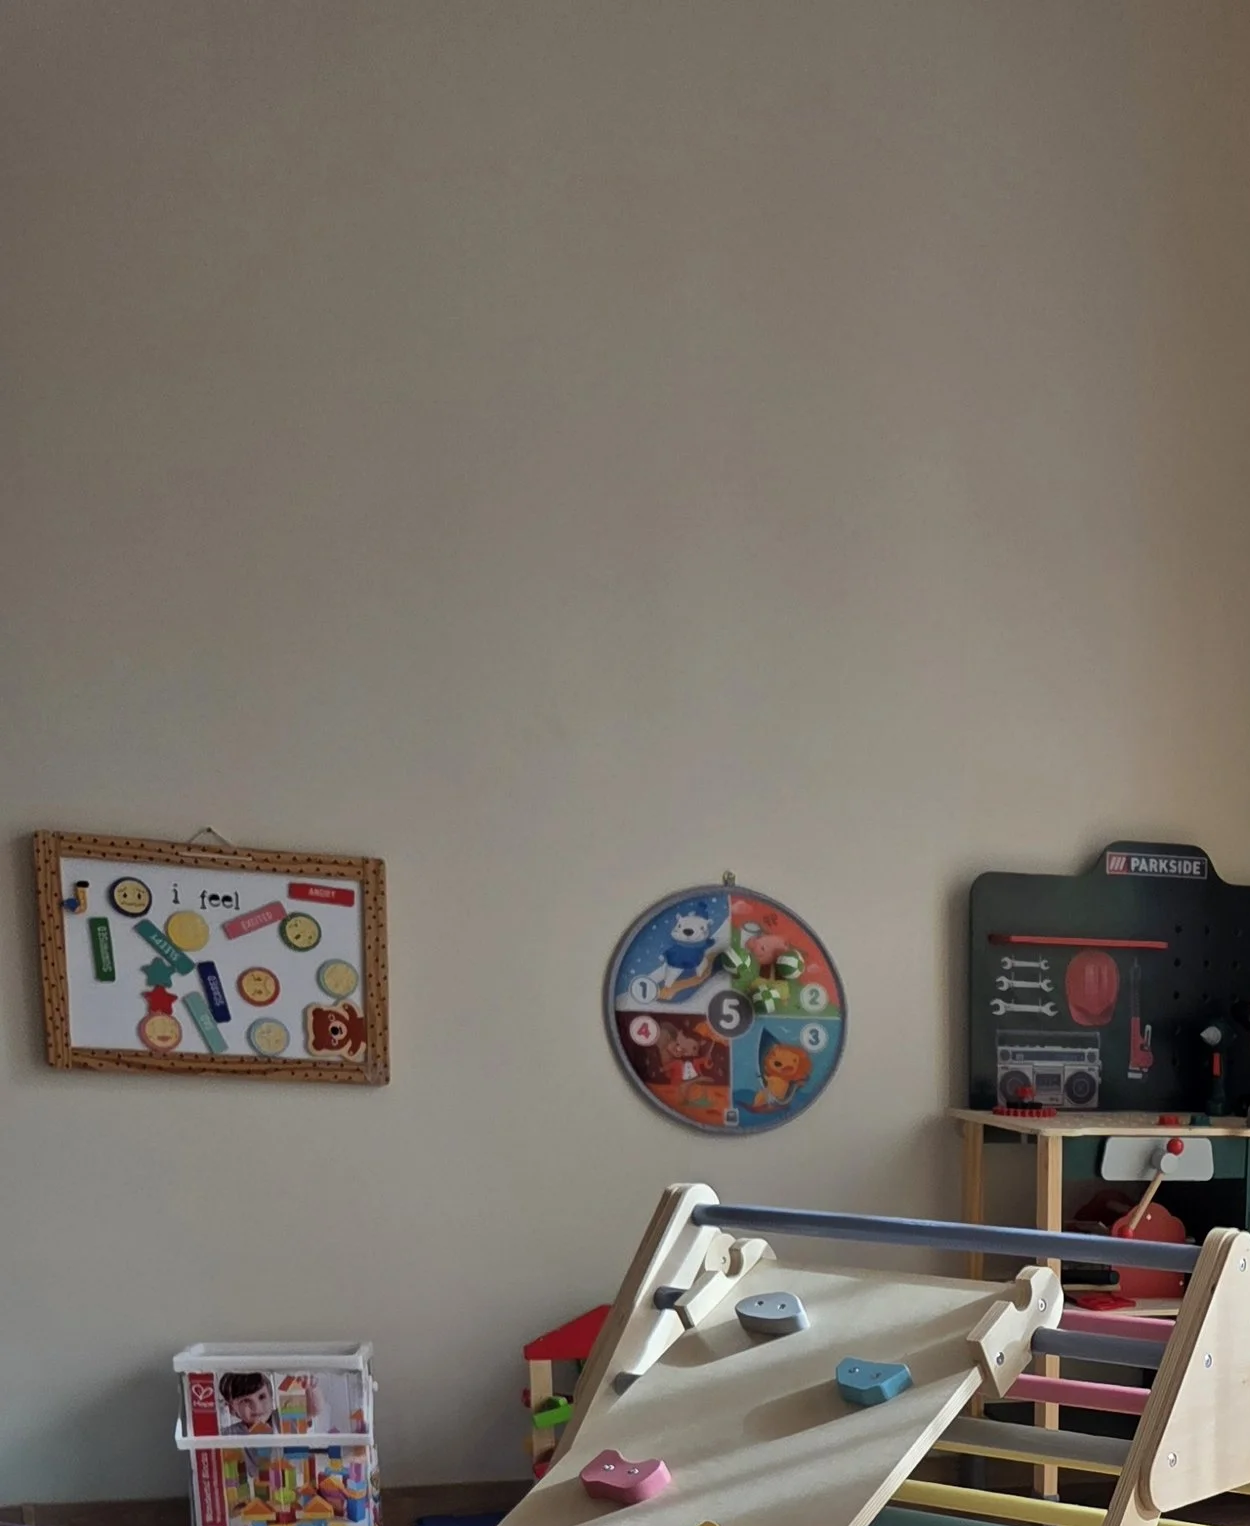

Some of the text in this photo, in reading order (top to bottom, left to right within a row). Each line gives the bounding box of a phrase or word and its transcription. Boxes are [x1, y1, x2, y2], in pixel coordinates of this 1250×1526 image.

[1130, 857, 1201, 875] PARKSIDE
[172, 883, 240, 910] i feel
[308, 887, 336, 899] ANGRY
[241, 911, 273, 931] EXCITED
[150, 933, 181, 961] SLEEPY
[207, 975, 225, 1007] SCARED
[638, 981, 648, 999] 1
[808, 987, 820, 1006] 2
[719, 999, 741, 1029] 5
[636, 1022, 651, 1040] 4
[808, 1028, 820, 1045] 3
